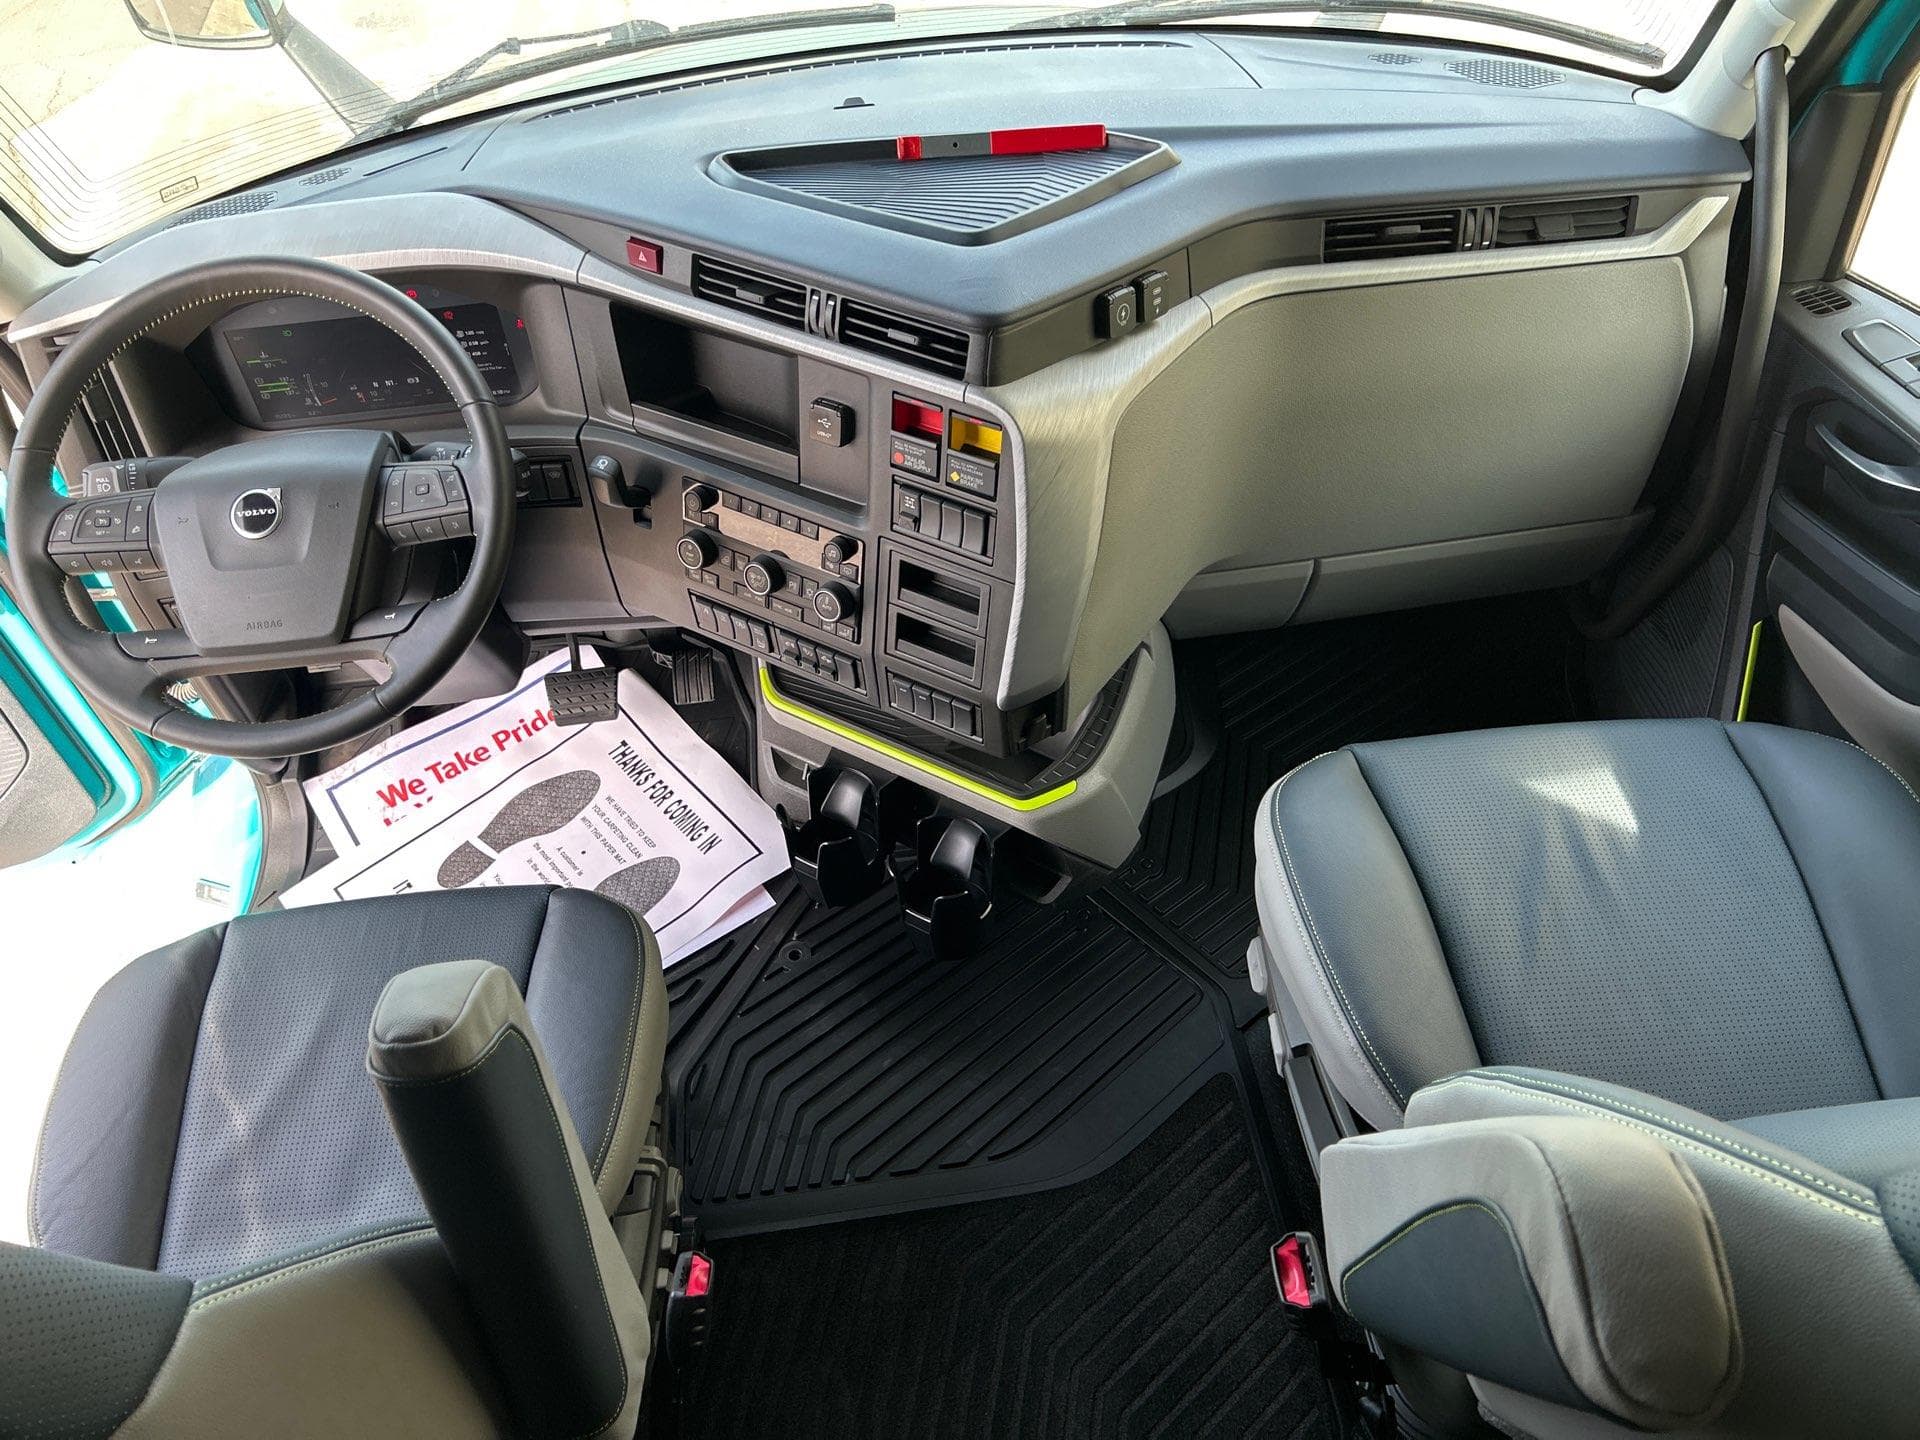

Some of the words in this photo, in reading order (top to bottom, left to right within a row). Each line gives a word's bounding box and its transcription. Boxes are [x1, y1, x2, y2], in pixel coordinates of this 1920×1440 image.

[236, 507, 276, 518] VOLVO
[246, 619, 283, 631] AIRBAG
[376, 778, 427, 808] We
[424, 745, 492, 784] Take
[608, 739, 656, 786] THANKS
[643, 779, 675, 807] FOR
[663, 799, 710, 842] COMING
[697, 832, 722, 855] IN
